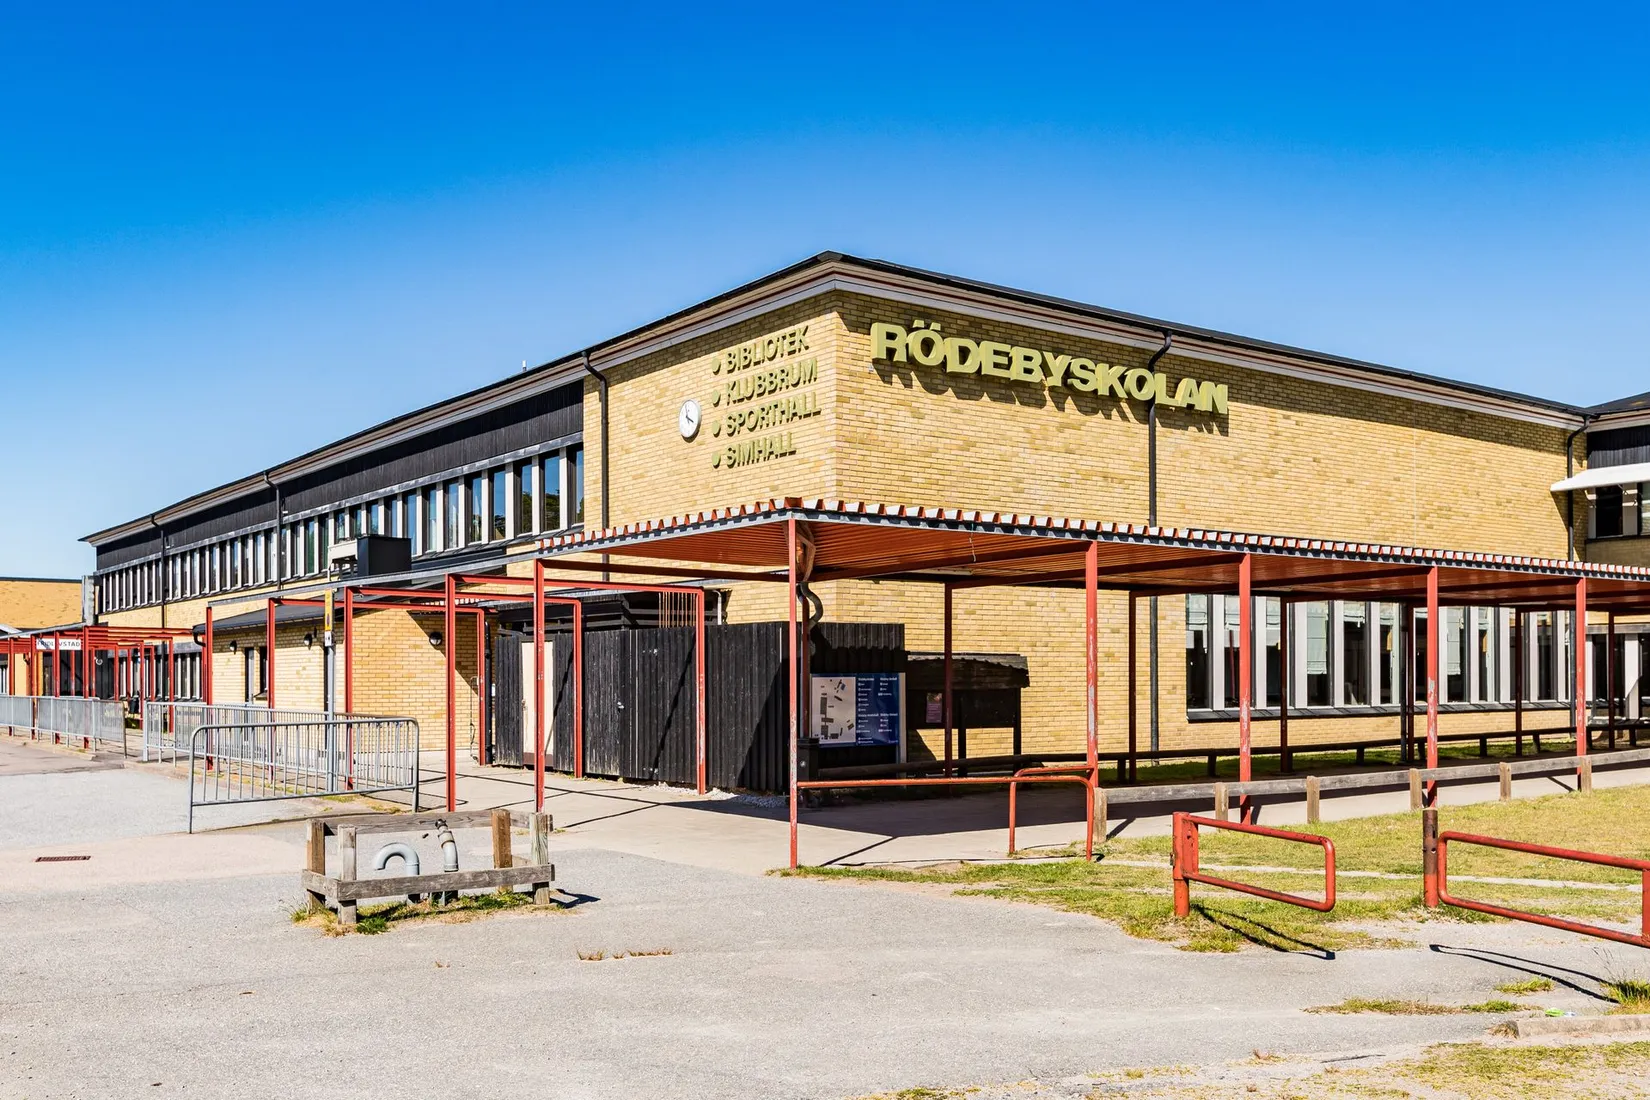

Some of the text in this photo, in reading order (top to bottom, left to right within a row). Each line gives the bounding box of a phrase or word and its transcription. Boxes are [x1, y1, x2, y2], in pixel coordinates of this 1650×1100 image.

[725, 325, 809, 374] BIBLIOTEK
[871, 320, 1228, 414] RÖDEBYSKOLAN
[725, 356, 818, 405] KLUBBRUM
[726, 391, 821, 436] SPORTHALL
[726, 431, 796, 468] SIMHALL
